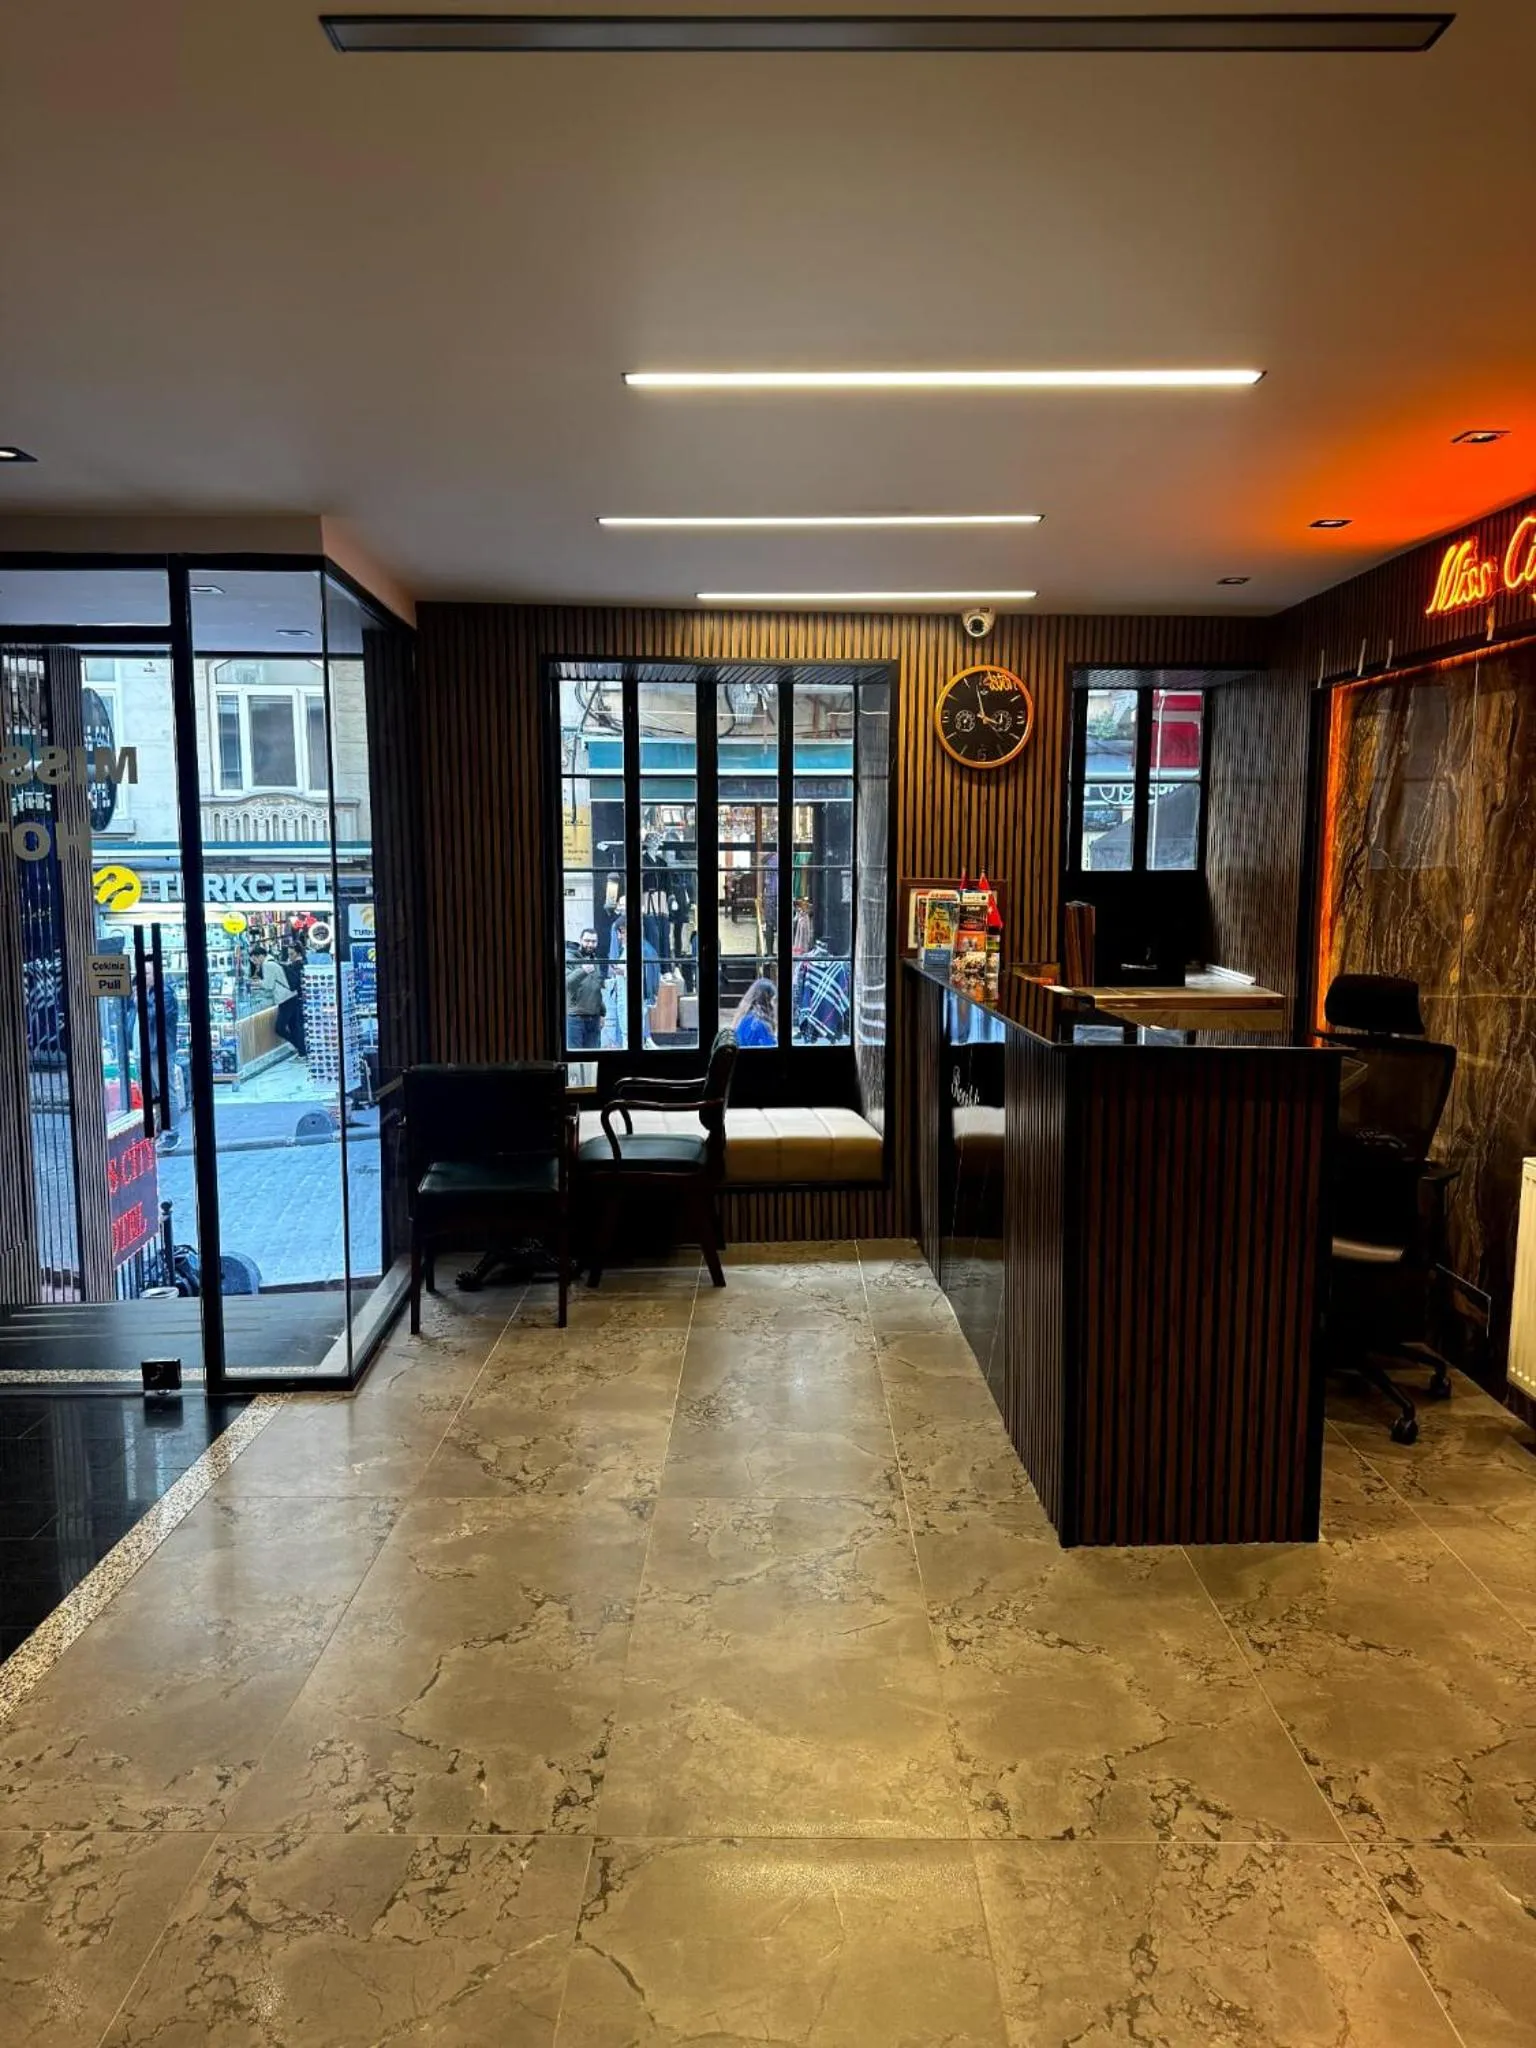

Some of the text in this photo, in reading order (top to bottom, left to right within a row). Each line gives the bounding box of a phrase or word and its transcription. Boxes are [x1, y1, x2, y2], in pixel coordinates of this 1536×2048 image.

[1425, 540, 1491, 614] Miss
[92, 961, 125, 971] Çekiniz
[99, 980, 121, 989] Pull
